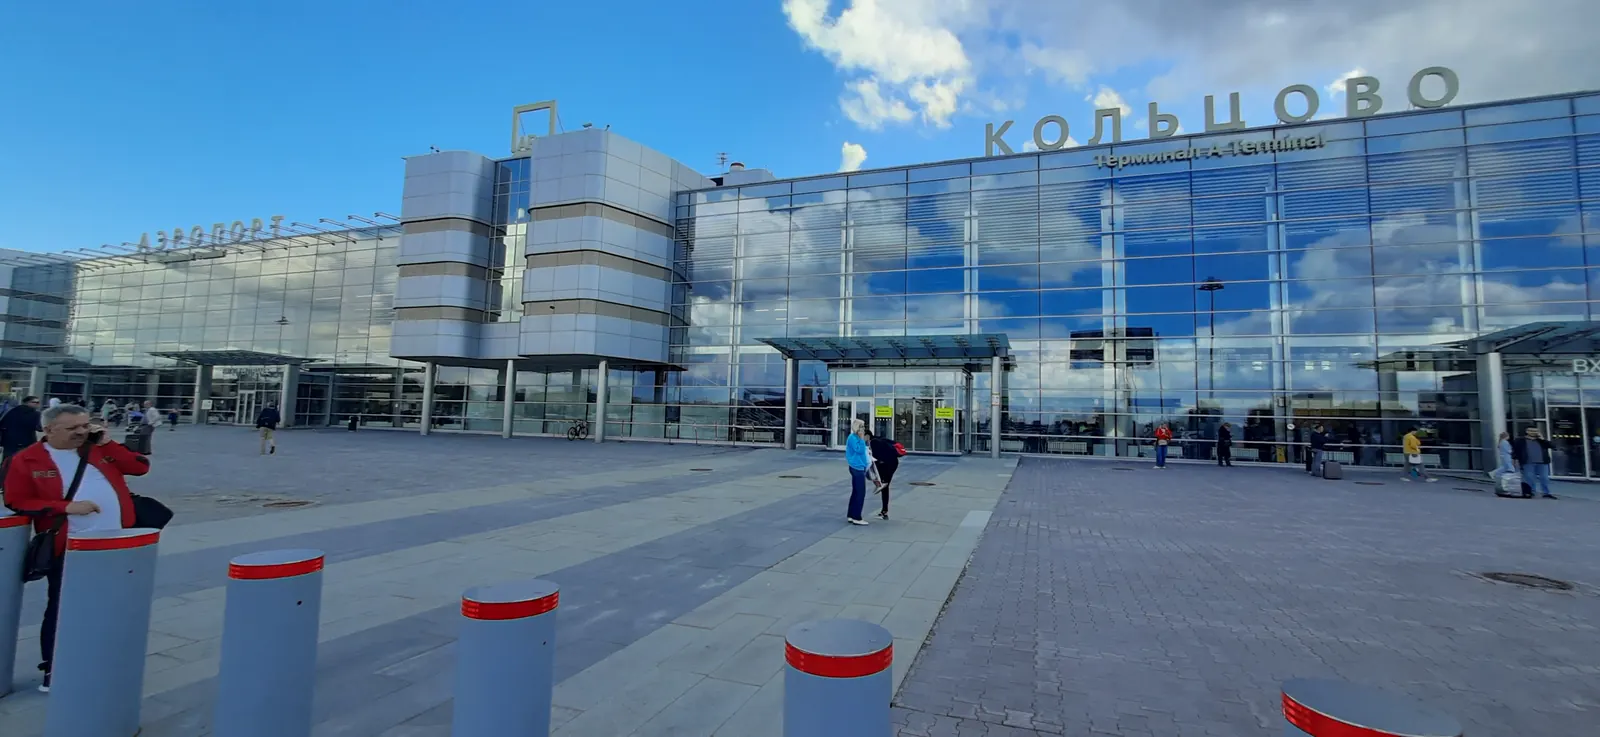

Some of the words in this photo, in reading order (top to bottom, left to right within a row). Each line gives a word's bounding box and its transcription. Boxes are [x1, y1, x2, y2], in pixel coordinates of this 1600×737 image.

[984, 66, 1460, 157] КОЛЬЦОВО
[1096, 147, 1199, 170] Терминал
[1232, 134, 1326, 157] Terminal
[137, 215, 285, 253] АЭРОПОРТ
